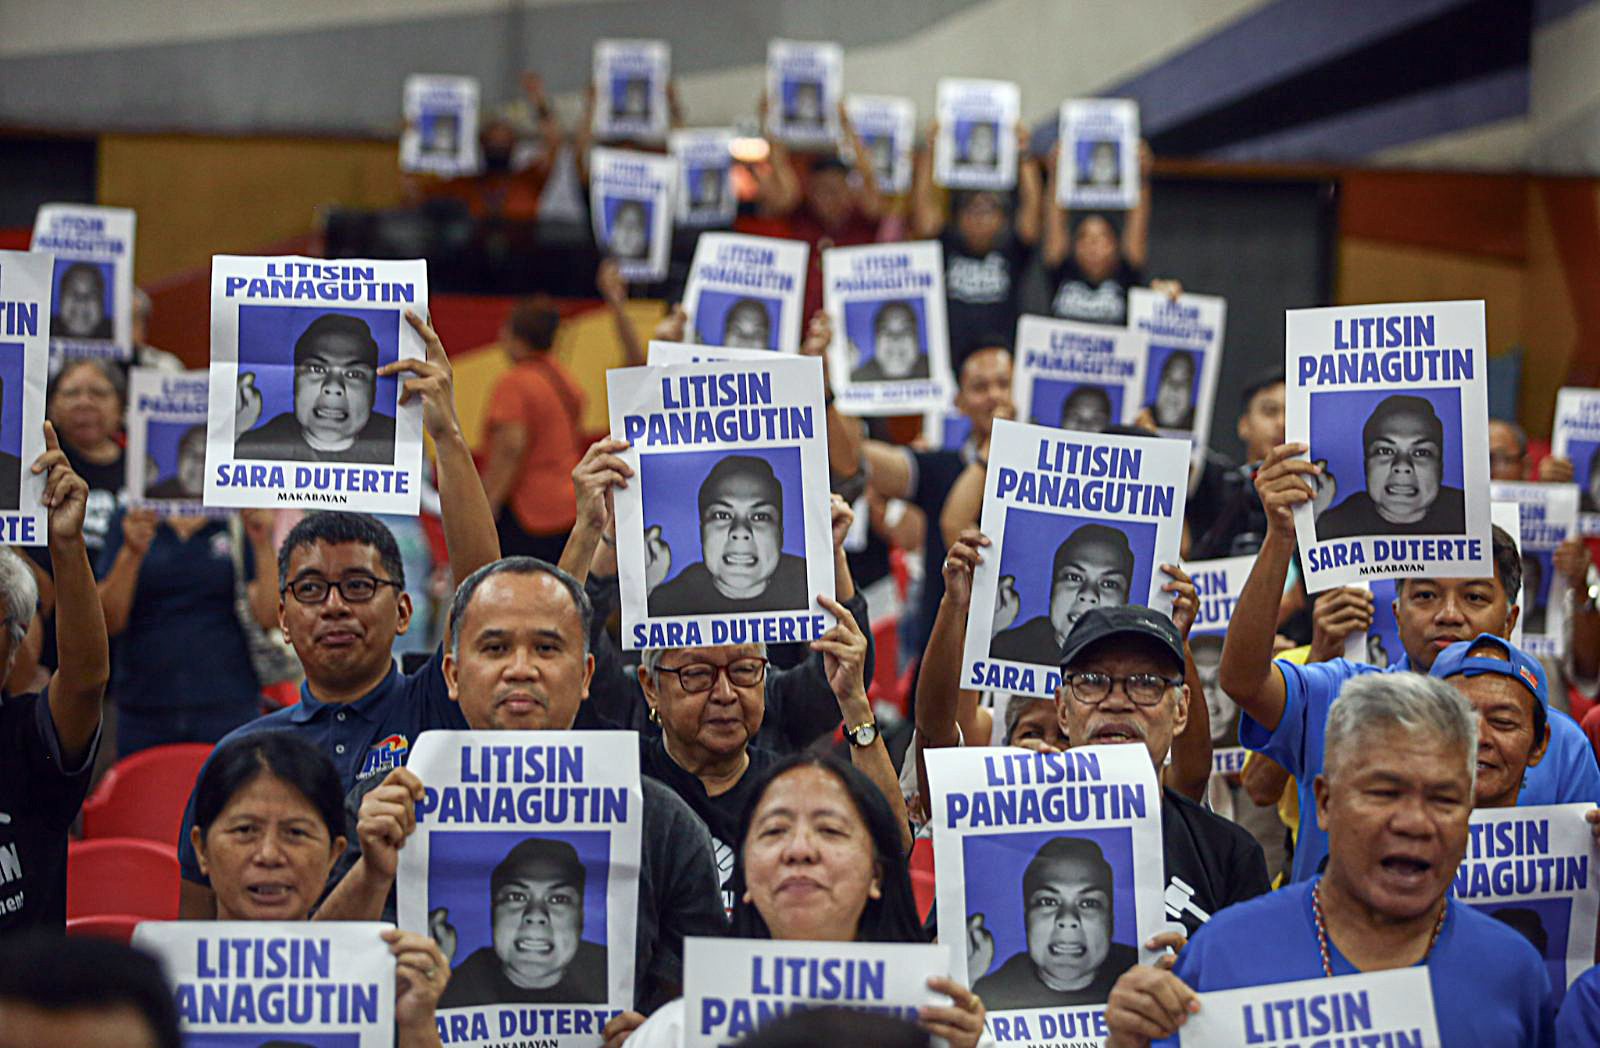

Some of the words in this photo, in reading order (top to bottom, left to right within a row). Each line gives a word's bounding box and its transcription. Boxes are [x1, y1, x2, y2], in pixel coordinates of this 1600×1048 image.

[225, 277, 414, 302] PANAGUTIN
[267, 264, 374, 280] LITISIN
[1334, 315, 1435, 350] LITISIN
[1298, 349, 1474, 386] PANAGUTIN
[661, 372, 772, 409] LITISIN
[624, 406, 814, 447] PANAGUTIN
[1037, 439, 1142, 479] LITISIN
[216, 465, 284, 488] SARA
[296, 468, 408, 493] DUTERTE
[996, 467, 1174, 517] PANAGUTIN
[276, 492, 349, 504] MAKABAYAN
[1308, 542, 1365, 572] SARA
[1374, 540, 1481, 560] DUTERTE
[1358, 562, 1426, 576] MAKABAYAN
[634, 621, 702, 647] SARA
[712, 616, 824, 644] DUTERTE
[971, 662, 1035, 693] SARA
[461, 746, 583, 783] LITISIN
[984, 752, 1101, 786] LITISIN
[415, 786, 627, 824] PANAGUTIN
[946, 784, 1146, 829] PANAGUTIN
[1466, 819, 1549, 859] TISIN
[1452, 855, 1588, 899] NAGUTIN
[197, 939, 329, 979] LITISIN
[752, 957, 884, 1000] LITISIN
[176, 984, 379, 1023] ANAGUTIN
[1242, 991, 1372, 1045] LITISIN
[434, 1010, 491, 1044] ARA
[497, 1007, 625, 1039] DUTERT
